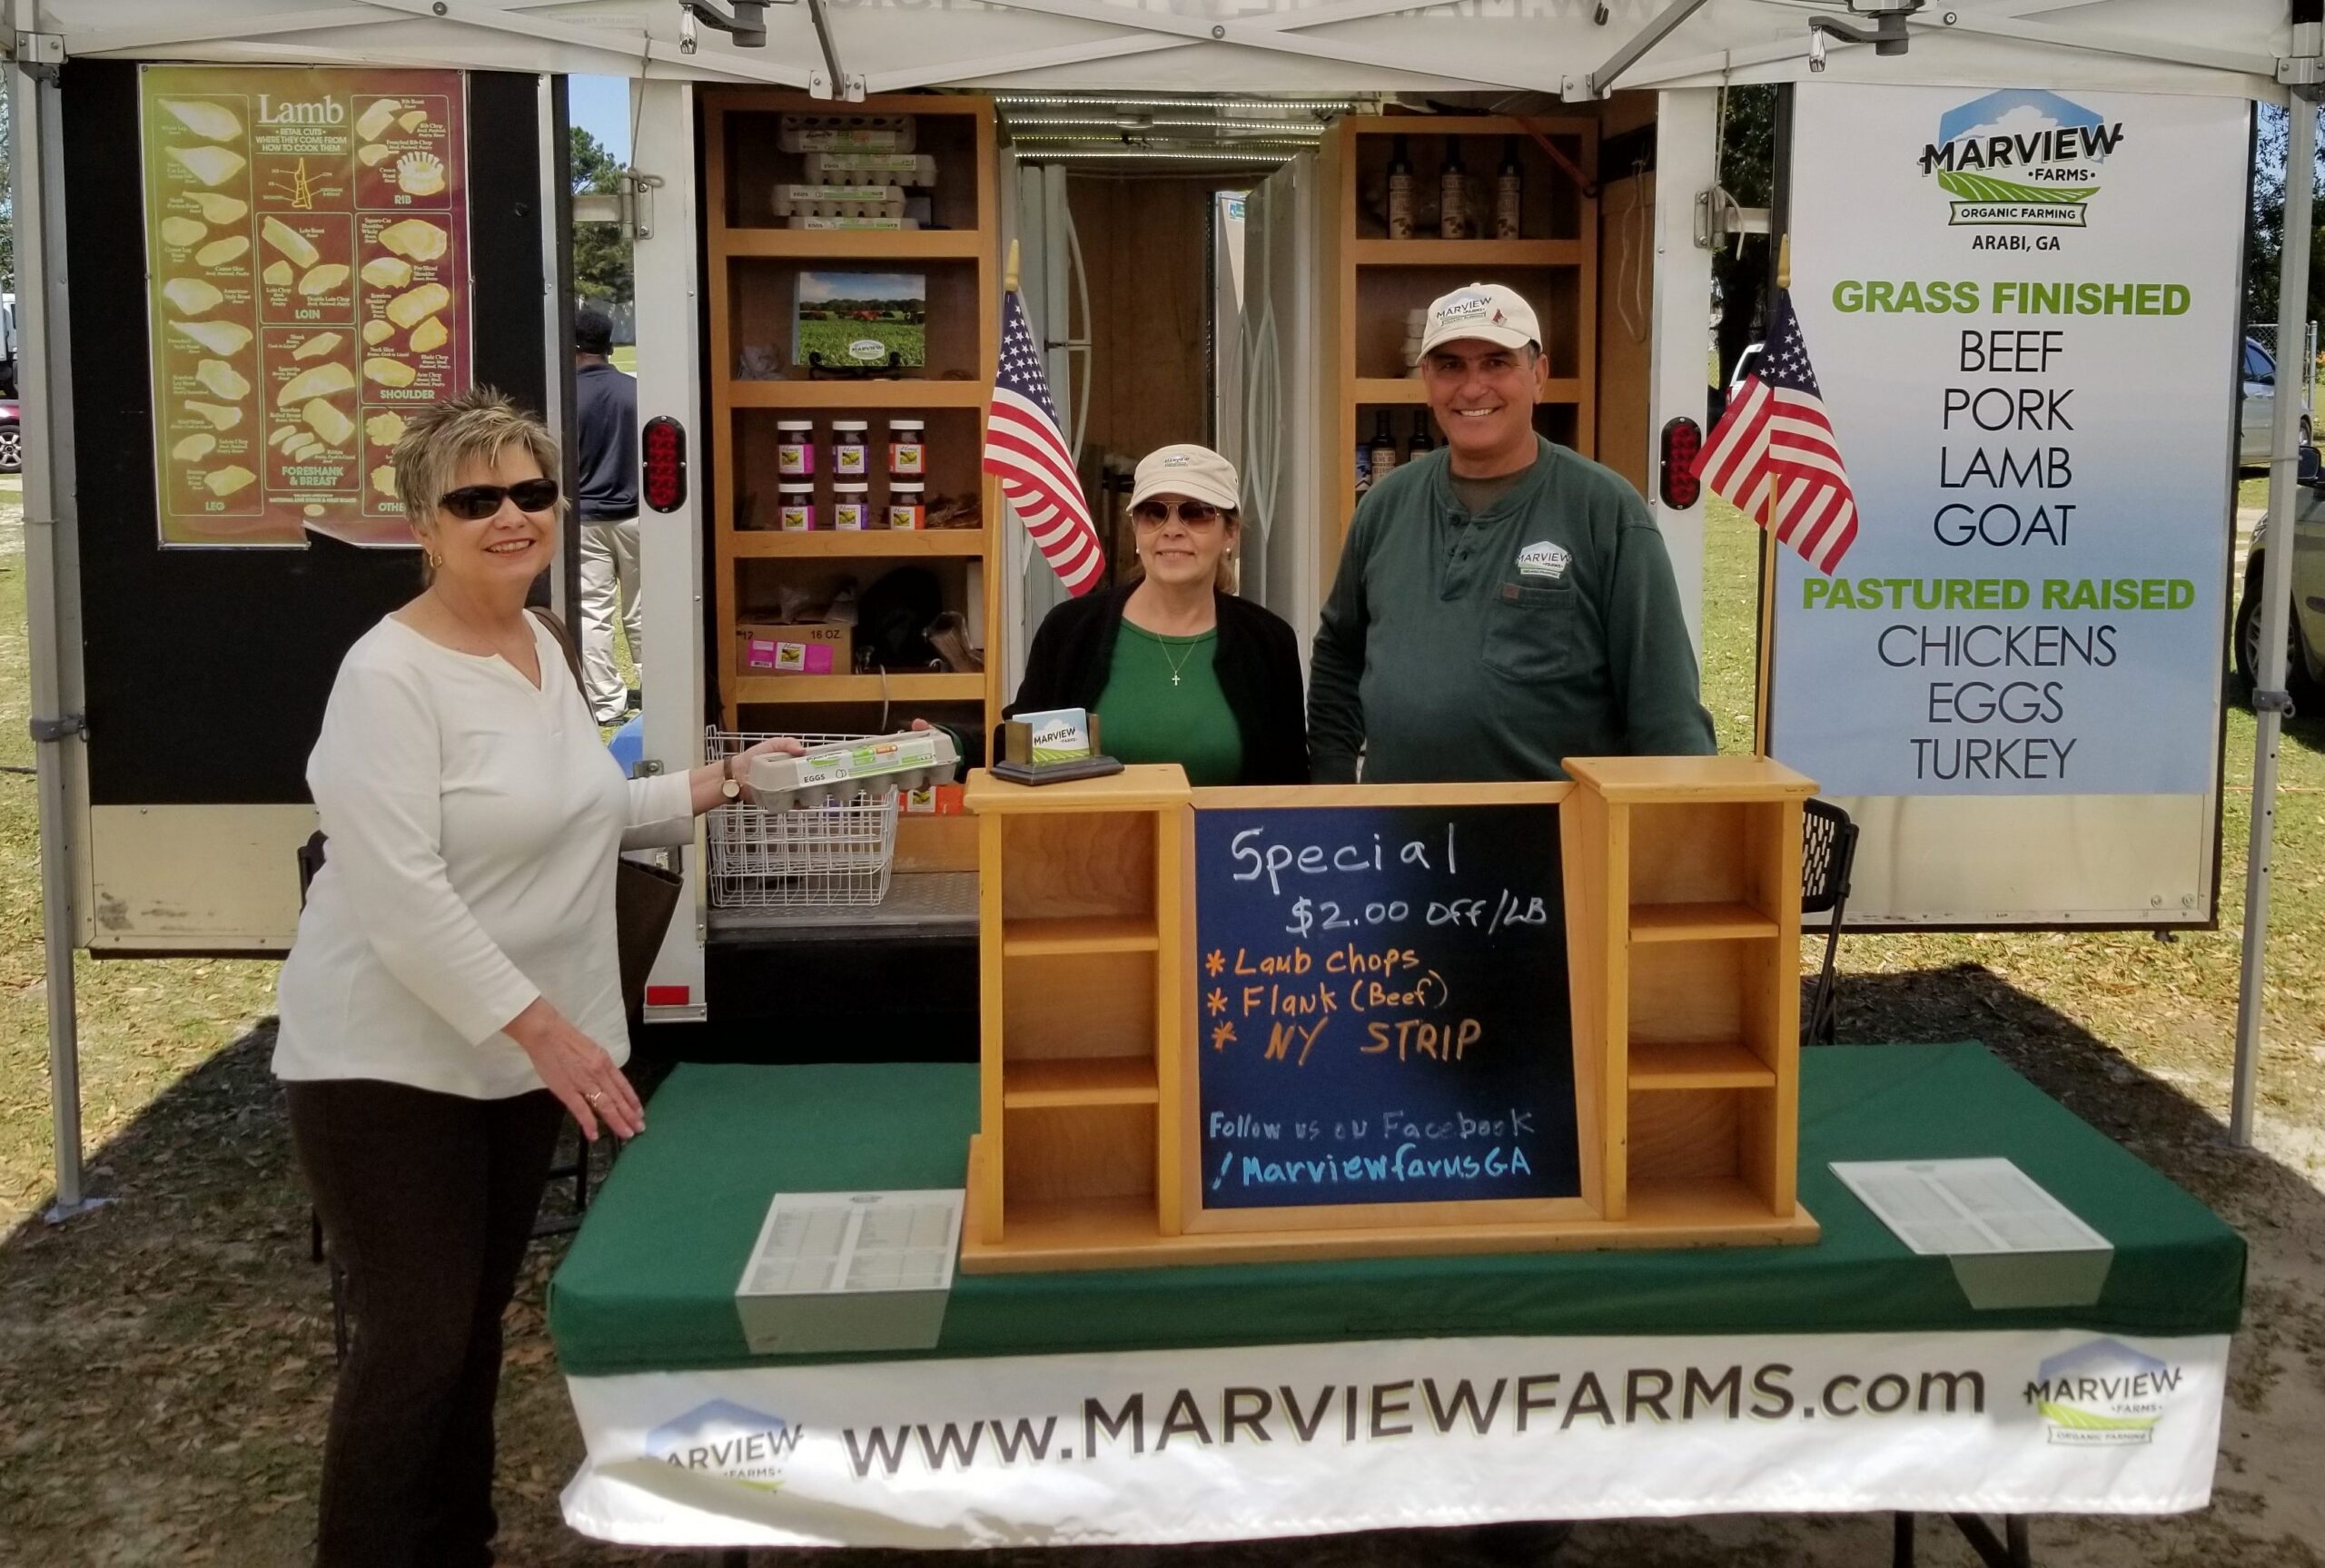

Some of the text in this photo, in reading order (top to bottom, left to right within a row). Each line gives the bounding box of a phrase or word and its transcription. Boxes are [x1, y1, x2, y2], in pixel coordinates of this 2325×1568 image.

[257, 94, 344, 123] Lamb
[255, 135, 280, 144] WHERE
[324, 136, 347, 144] FROM
[262, 143, 281, 152] HOW
[1918, 123, 2124, 176] MARVIEW
[394, 194, 411, 204] RIB
[1961, 208, 2076, 219] ORGANIC FARMING
[1972, 235, 2061, 252] ARABI, GA
[295, 310, 321, 319] LOIN
[1436, 297, 1492, 320] MARVIEW
[1832, 281, 2191, 316] GRASS FINISHED
[1960, 330, 2064, 373] BEEF
[380, 390, 435, 399] SHOULDER
[1944, 388, 2075, 431] PORK
[282, 467, 343, 476] FORESHANK
[290, 477, 337, 486] & BREAST
[1940, 446, 2073, 489] LAMB
[205, 501, 225, 511] LEG
[1934, 503, 2077, 547] GOAT
[1516, 553, 1572, 564] MARVIEW
[1802, 577, 2195, 611] PASTURED RAISED
[1877, 624, 2118, 668] CHICKENS
[1928, 680, 2064, 725] EGGS
[1034, 726, 1076, 746] MARVIEW
[1910, 737, 2077, 780] TURKEY
[804, 774, 826, 783] EGGS
[1231, 822, 1456, 895] Special
[1286, 895, 1408, 938] $2.00
[1243, 969, 1449, 1017] Flank (Beef)
[1264, 1017, 1481, 1066] NY STRIP
[1209, 1110, 1281, 1139] Follow
[1295, 1120, 1319, 1139] us
[1382, 1108, 1535, 1139] Facebook
[2023, 1367, 2182, 1405] MARVIEW
[842, 1363, 1985, 1479] www.MARVIEWFARMS.com
